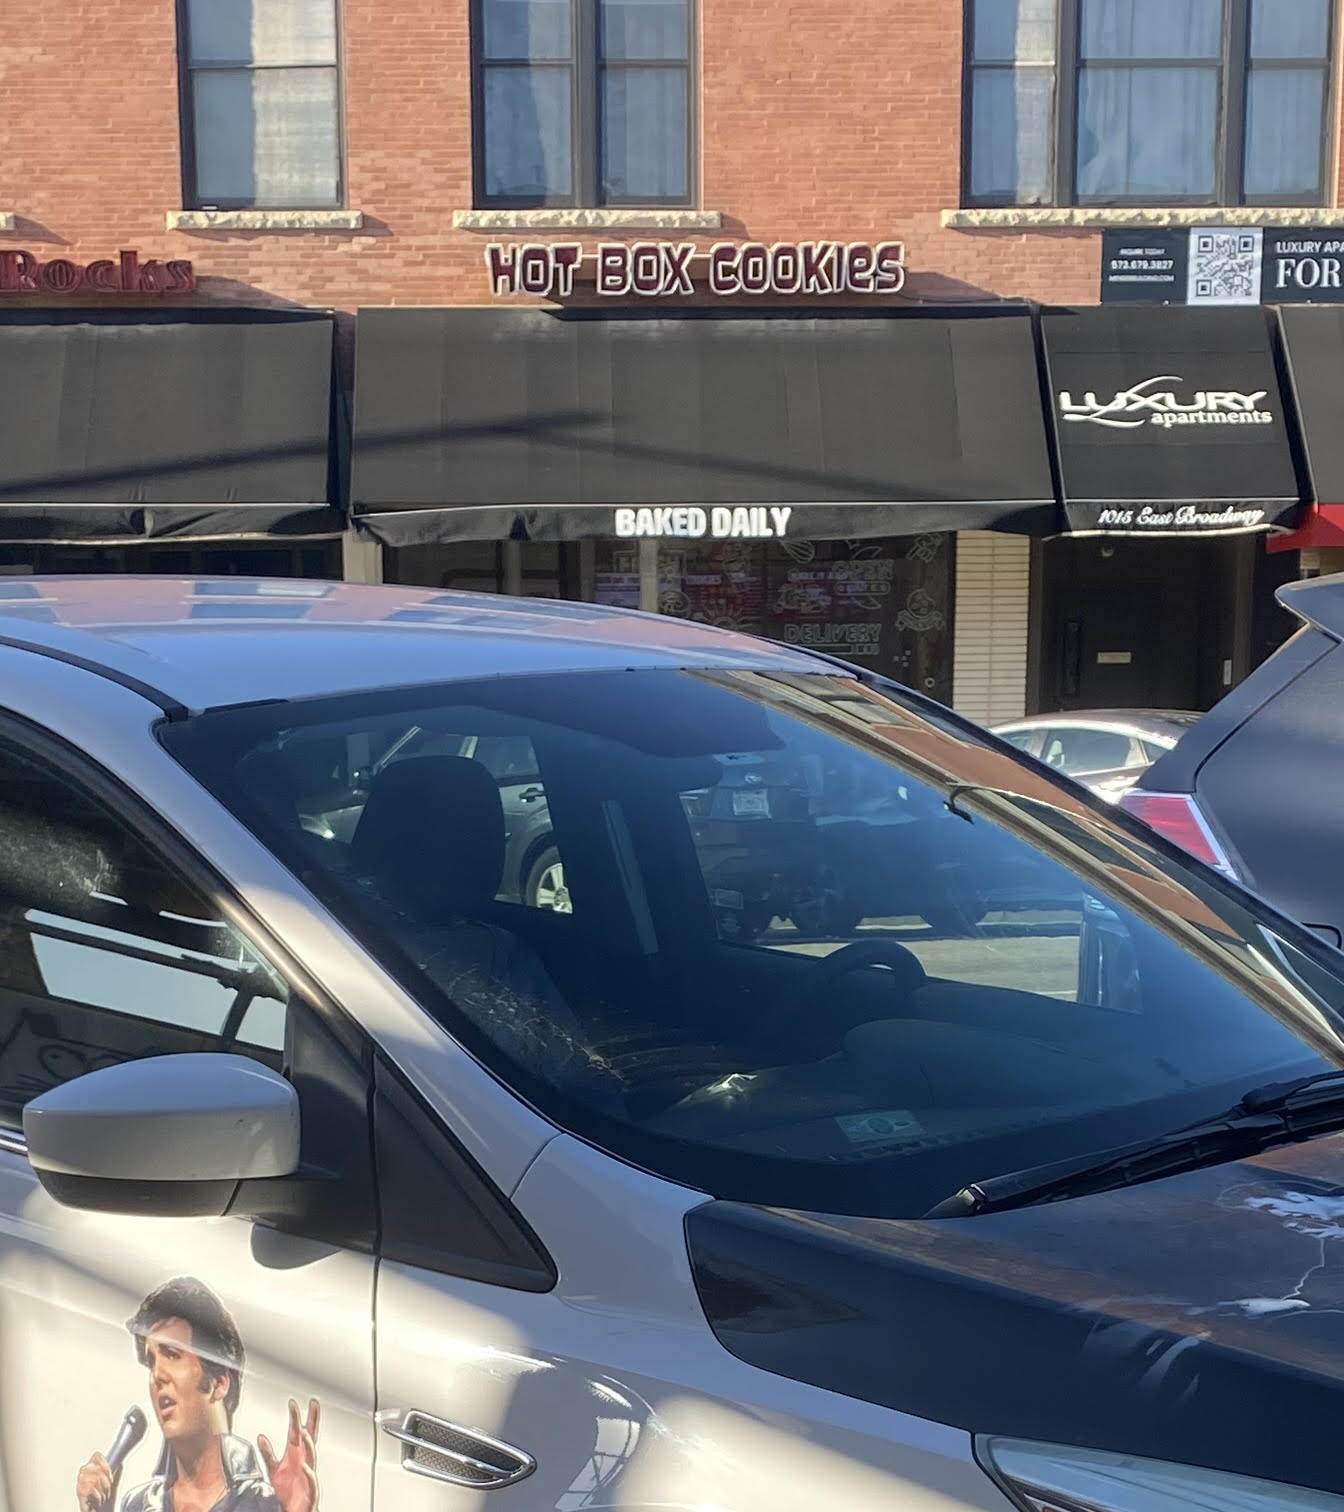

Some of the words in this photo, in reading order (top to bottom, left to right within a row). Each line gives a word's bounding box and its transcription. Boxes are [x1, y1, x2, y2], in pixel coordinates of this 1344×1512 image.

[1275, 241, 1322, 254] LUXURY
[485, 241, 582, 297] HOT
[597, 241, 696, 296] BOX
[1274, 257, 1344, 288] FOR
[1059, 380, 1269, 415] LUXURY
[1150, 408, 1273, 429] apartments
[615, 507, 706, 538] BAKED
[710, 506, 792, 538] DAILY
[1097, 509, 1135, 525] 1015
[1135, 506, 1174, 525] East
[1174, 505, 1265, 528] Broadway
[783, 623, 882, 643] DELIVERY
